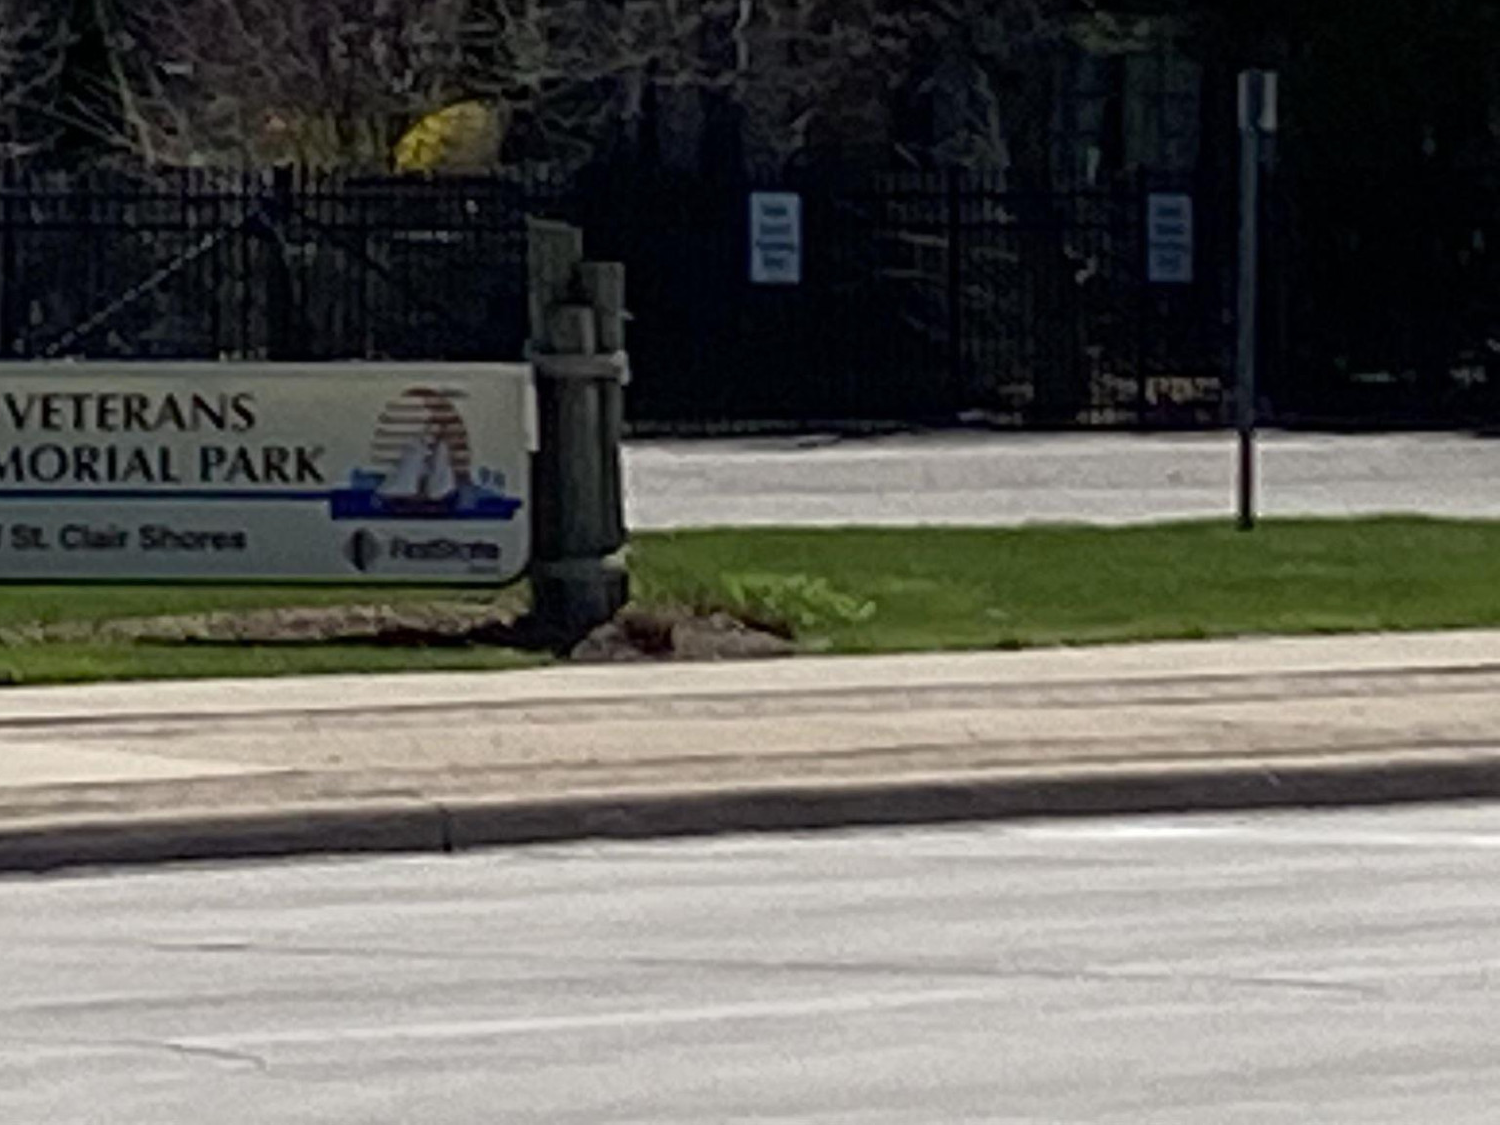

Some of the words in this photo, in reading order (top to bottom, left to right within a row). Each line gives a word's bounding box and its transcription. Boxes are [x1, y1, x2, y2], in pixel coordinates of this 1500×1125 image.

[2, 392, 257, 432] VETERANS
[200, 444, 326, 483] PARK
[59, 524, 130, 550] Clair
[138, 524, 248, 551] Shores
